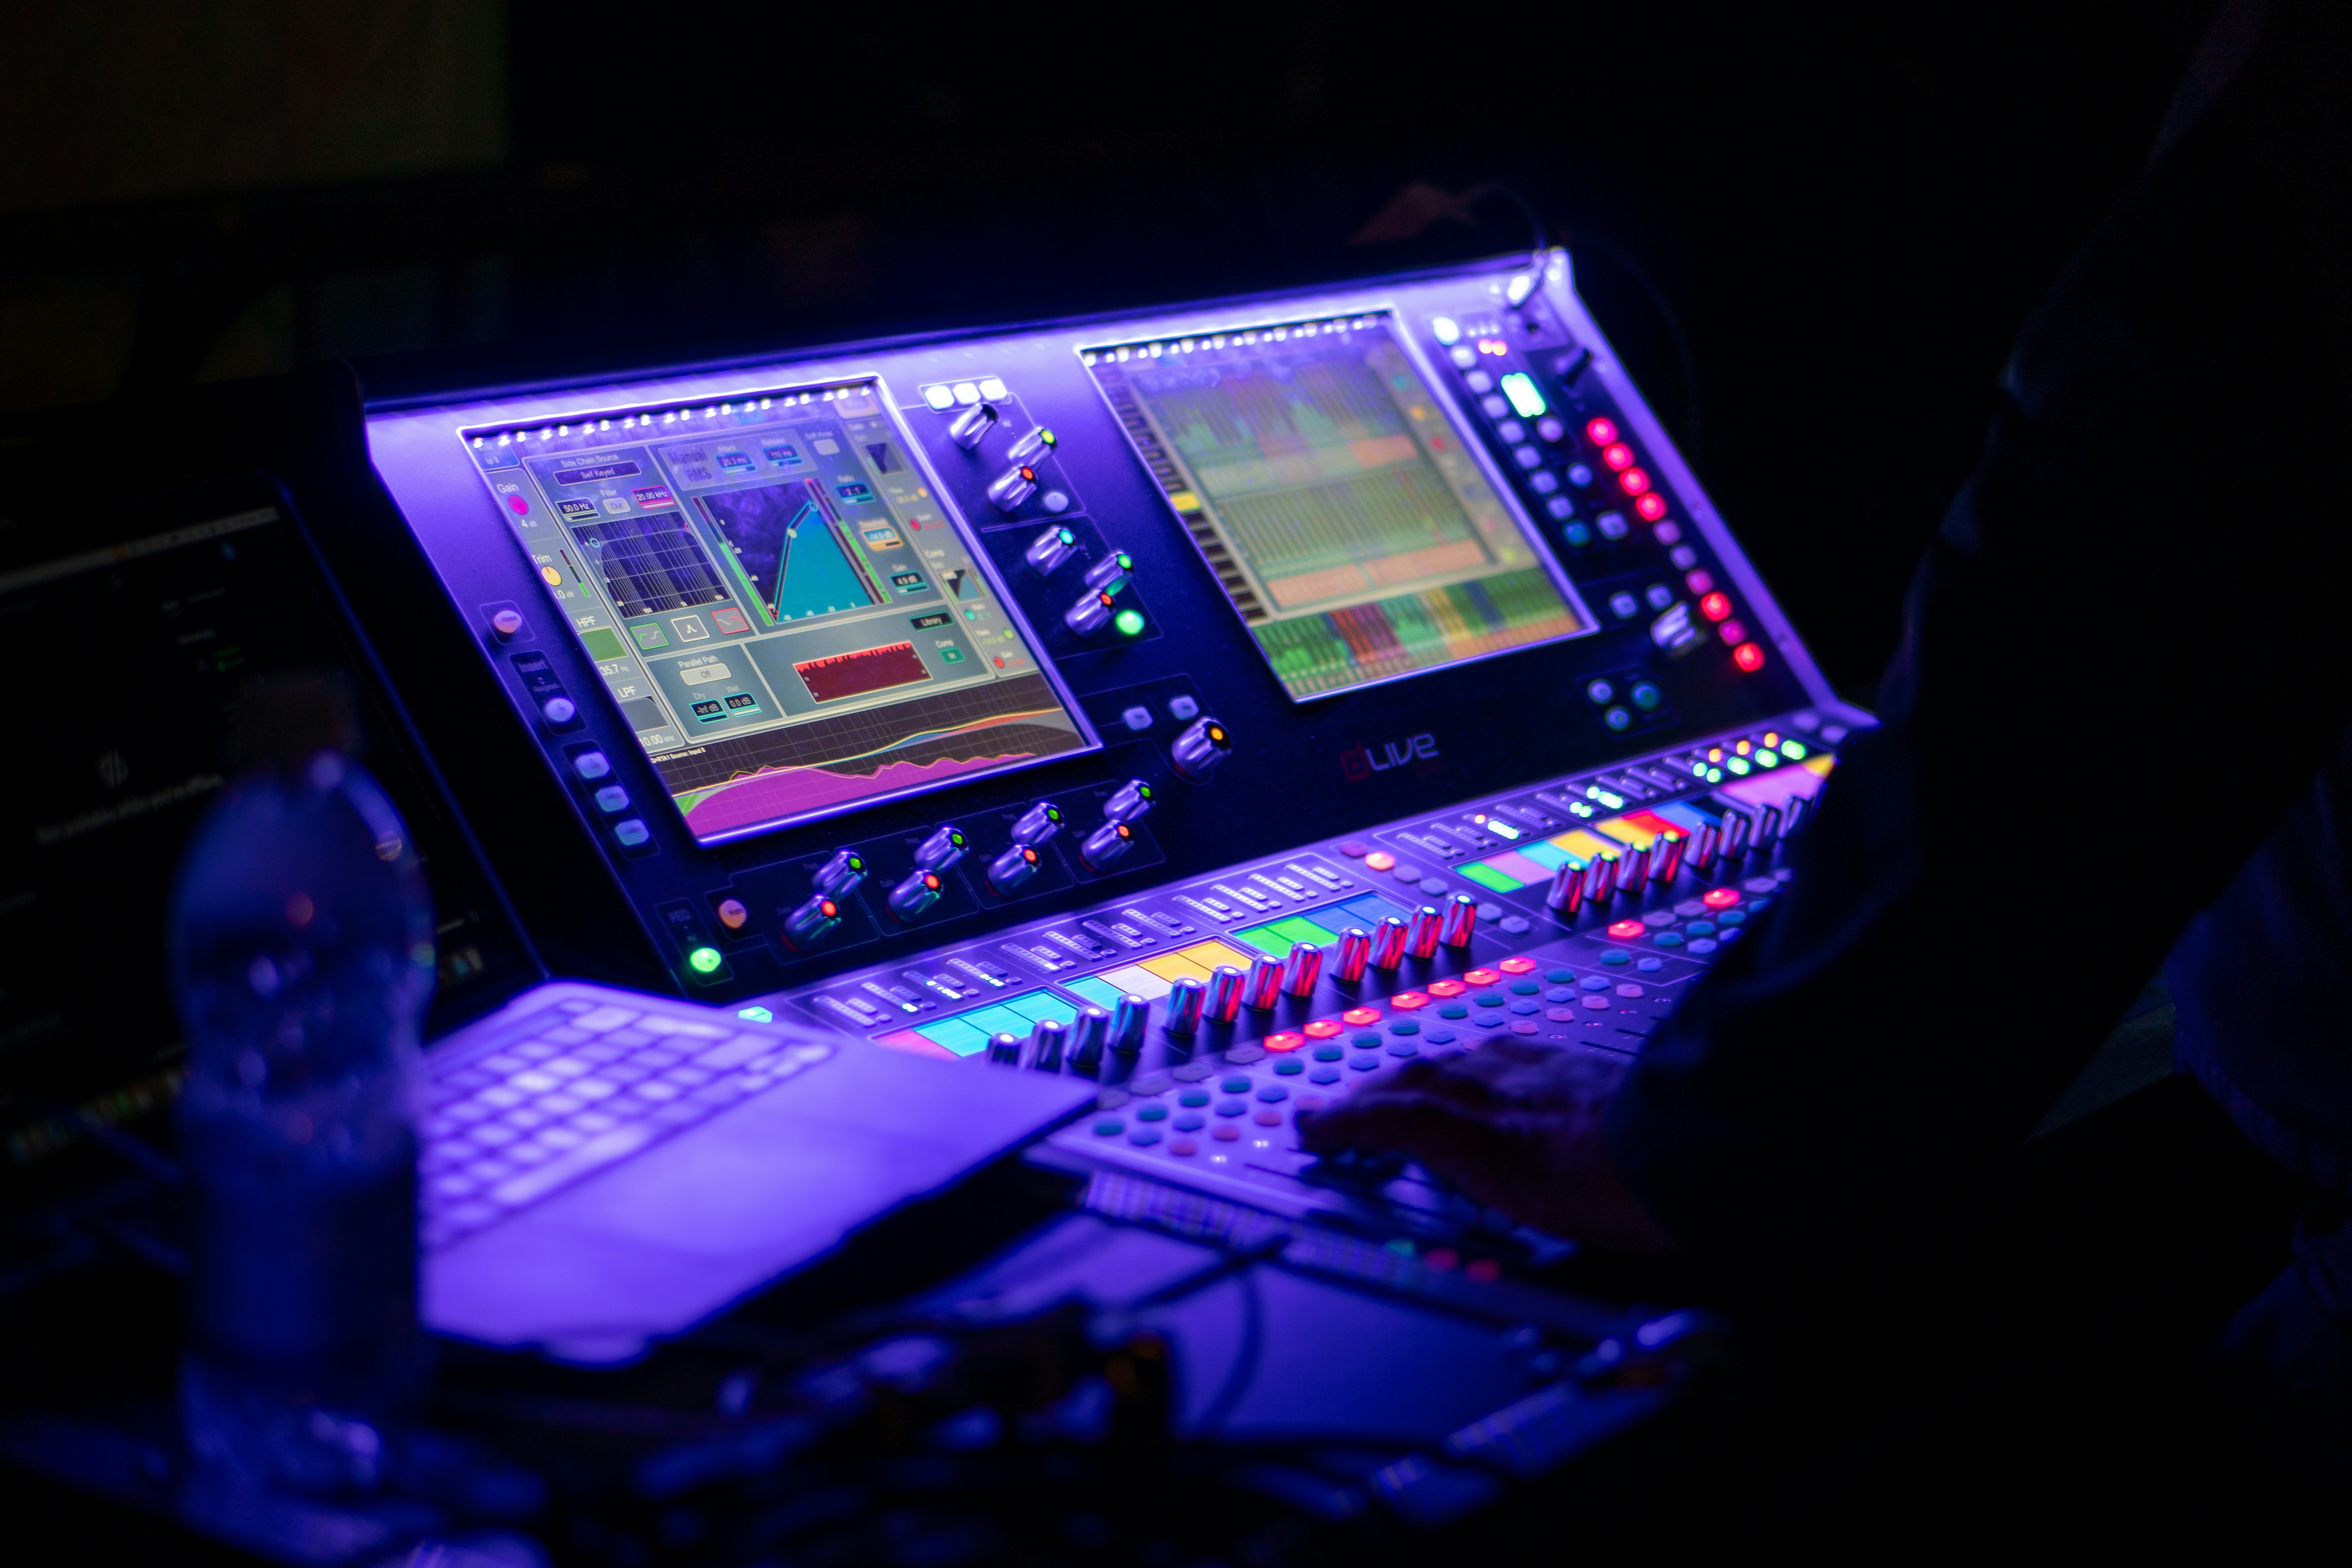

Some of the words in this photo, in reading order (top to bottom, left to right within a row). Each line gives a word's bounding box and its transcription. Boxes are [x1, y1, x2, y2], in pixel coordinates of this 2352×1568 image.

[577, 457, 596, 466] Chain
[596, 454, 619, 463] Source
[668, 448, 709, 465] Manual
[581, 471, 594, 479] Self
[594, 468, 615, 478] Keyed
[497, 483, 519, 493] Gain
[601, 489, 618, 497] Filter
[637, 492, 656, 501] 20.00
[654, 490, 669, 499] kHz
[563, 504, 579, 512] 50.0
[521, 519, 528, 528] 4
[532, 554, 552, 564] Trim
[576, 616, 596, 628] HPF
[920, 617, 942, 626] Library
[677, 657, 704, 669] Parallel
[703, 655, 719, 664] Path
[599, 663, 619, 676] 35.7
[701, 670, 712, 679] Off
[617, 686, 637, 698] LPF
[726, 685, 740, 693] Wet
[729, 699, 741, 708] 0.0
[741, 697, 752, 705] dB
[697, 706, 709, 715] -Inf
[708, 704, 720, 712] dB
[639, 734, 664, 747] 10.00
